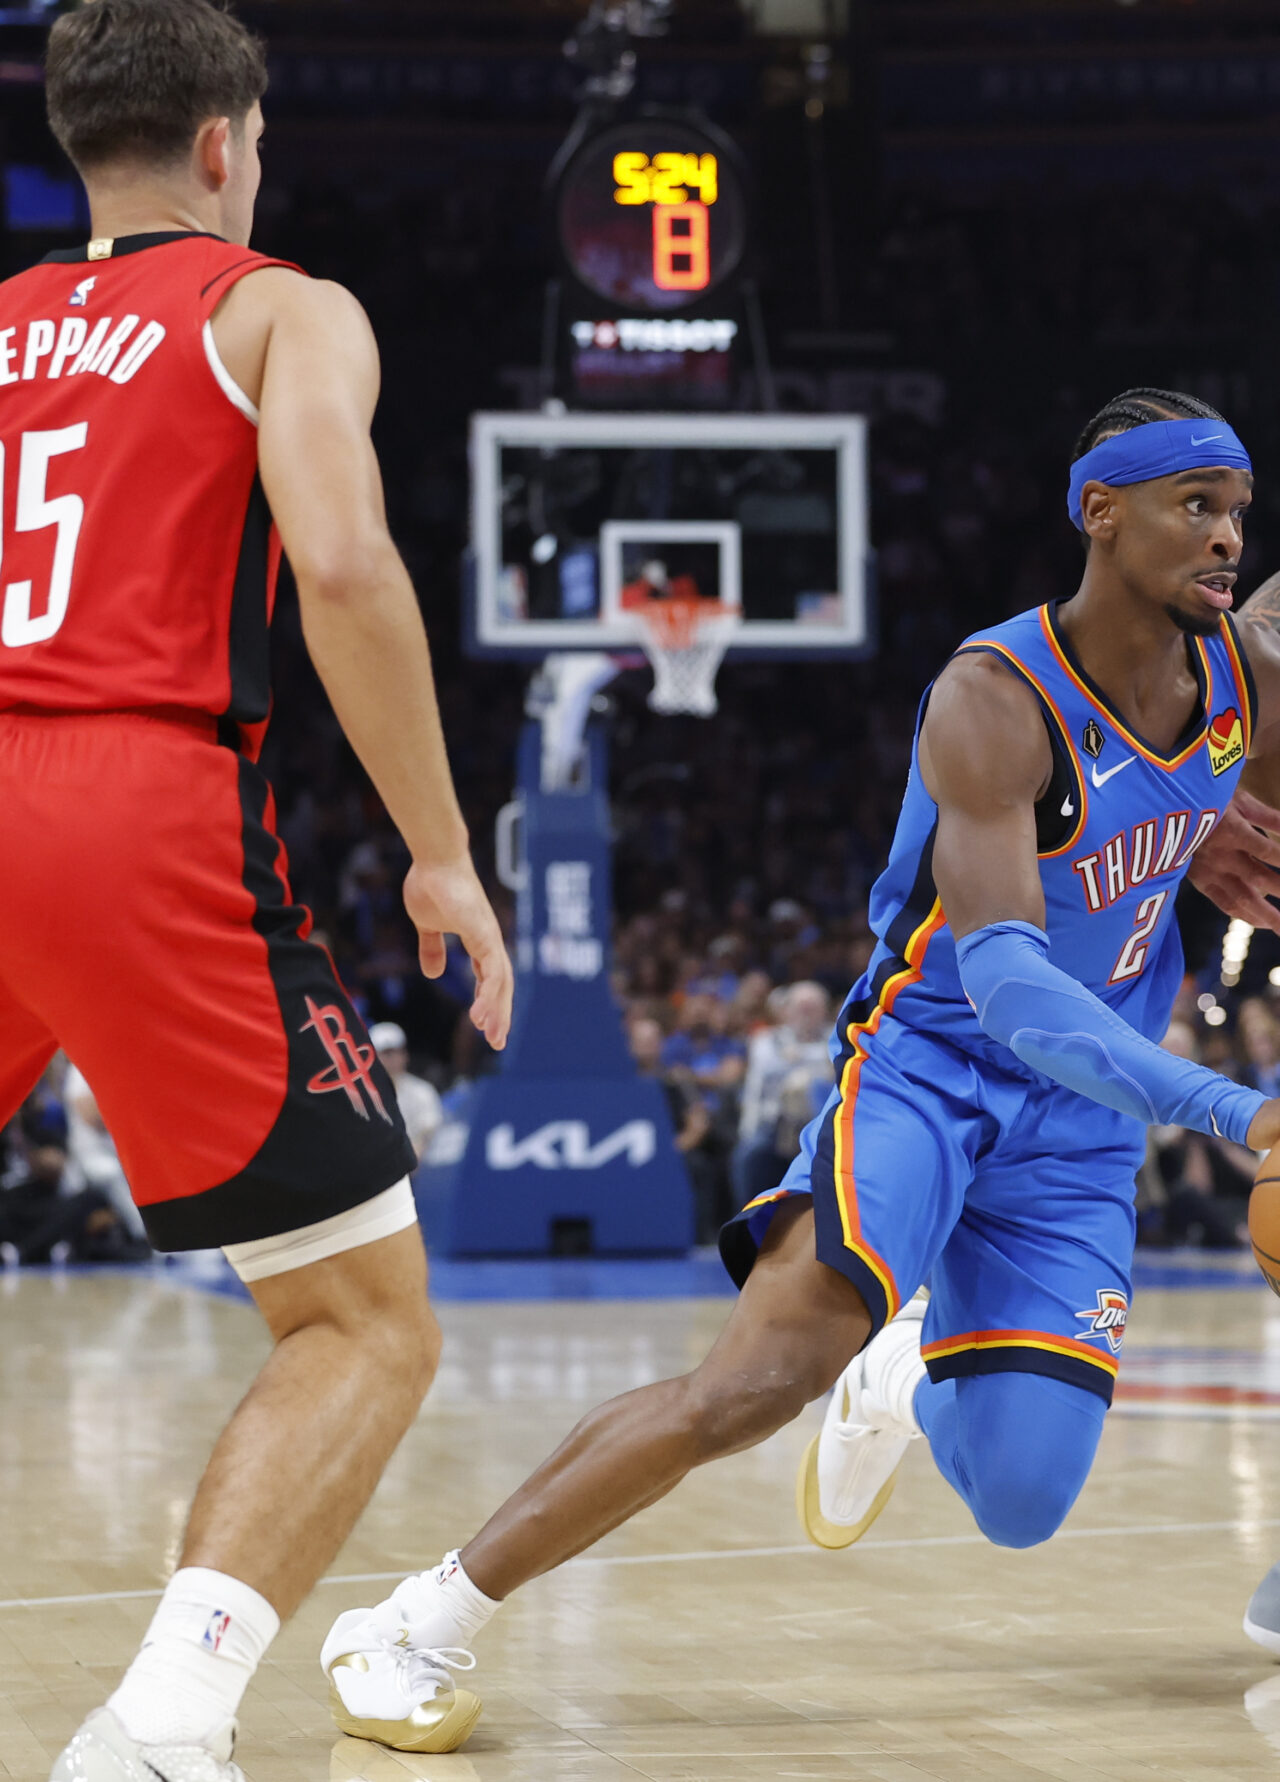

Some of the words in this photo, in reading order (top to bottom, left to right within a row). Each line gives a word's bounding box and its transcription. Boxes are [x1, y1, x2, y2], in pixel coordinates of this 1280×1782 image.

[651, 200, 711, 291] 8
[615, 318, 739, 352] TISSOT
[0, 421, 88, 648] 5
[1107, 889, 1169, 986] 2
